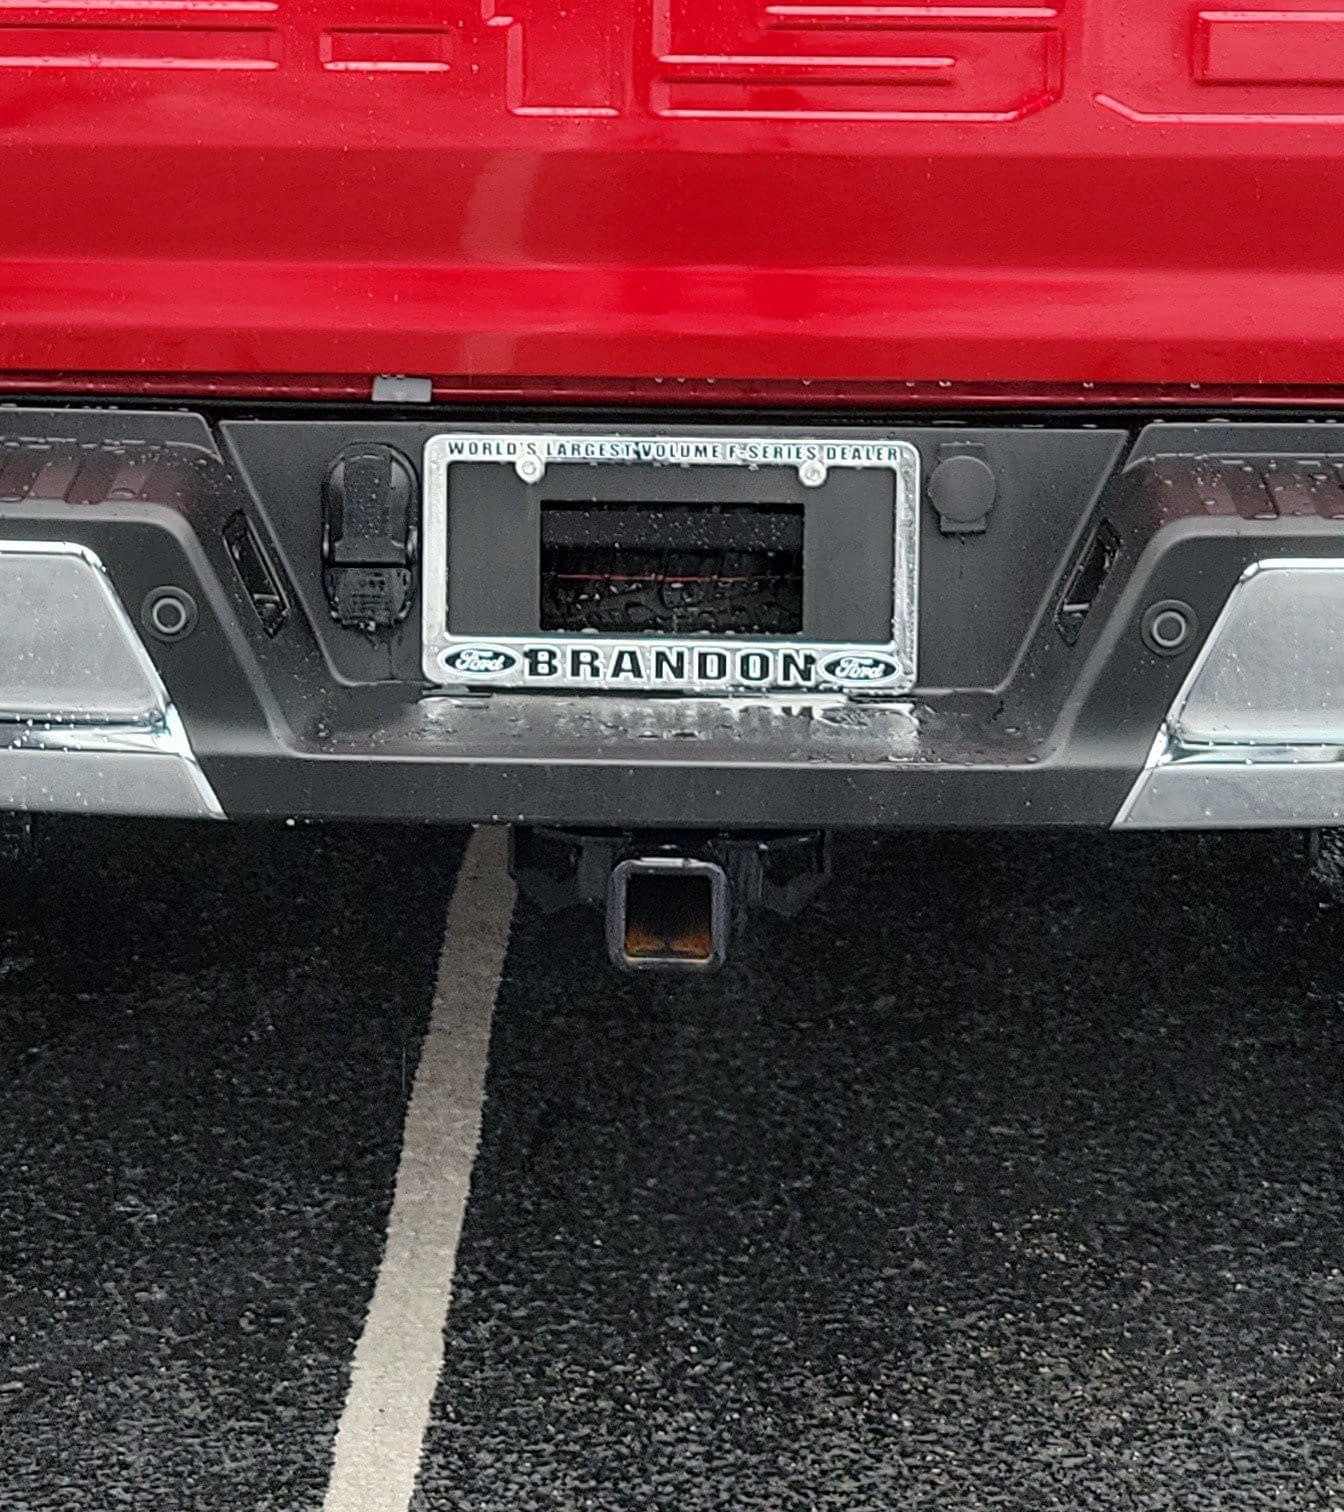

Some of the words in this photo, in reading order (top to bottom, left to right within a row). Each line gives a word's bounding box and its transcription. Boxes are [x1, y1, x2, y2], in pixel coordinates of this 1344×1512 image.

[448, 441, 537, 456] WORLD'S
[546, 441, 632, 457] LARGEST
[638, 443, 720, 459] VOLUME
[729, 444, 817, 460] F-SERIES
[826, 445, 899, 461] DEALER
[455, 648, 505, 672] Ford
[525, 647, 815, 682] BRANDON
[834, 656, 886, 679] Ford
